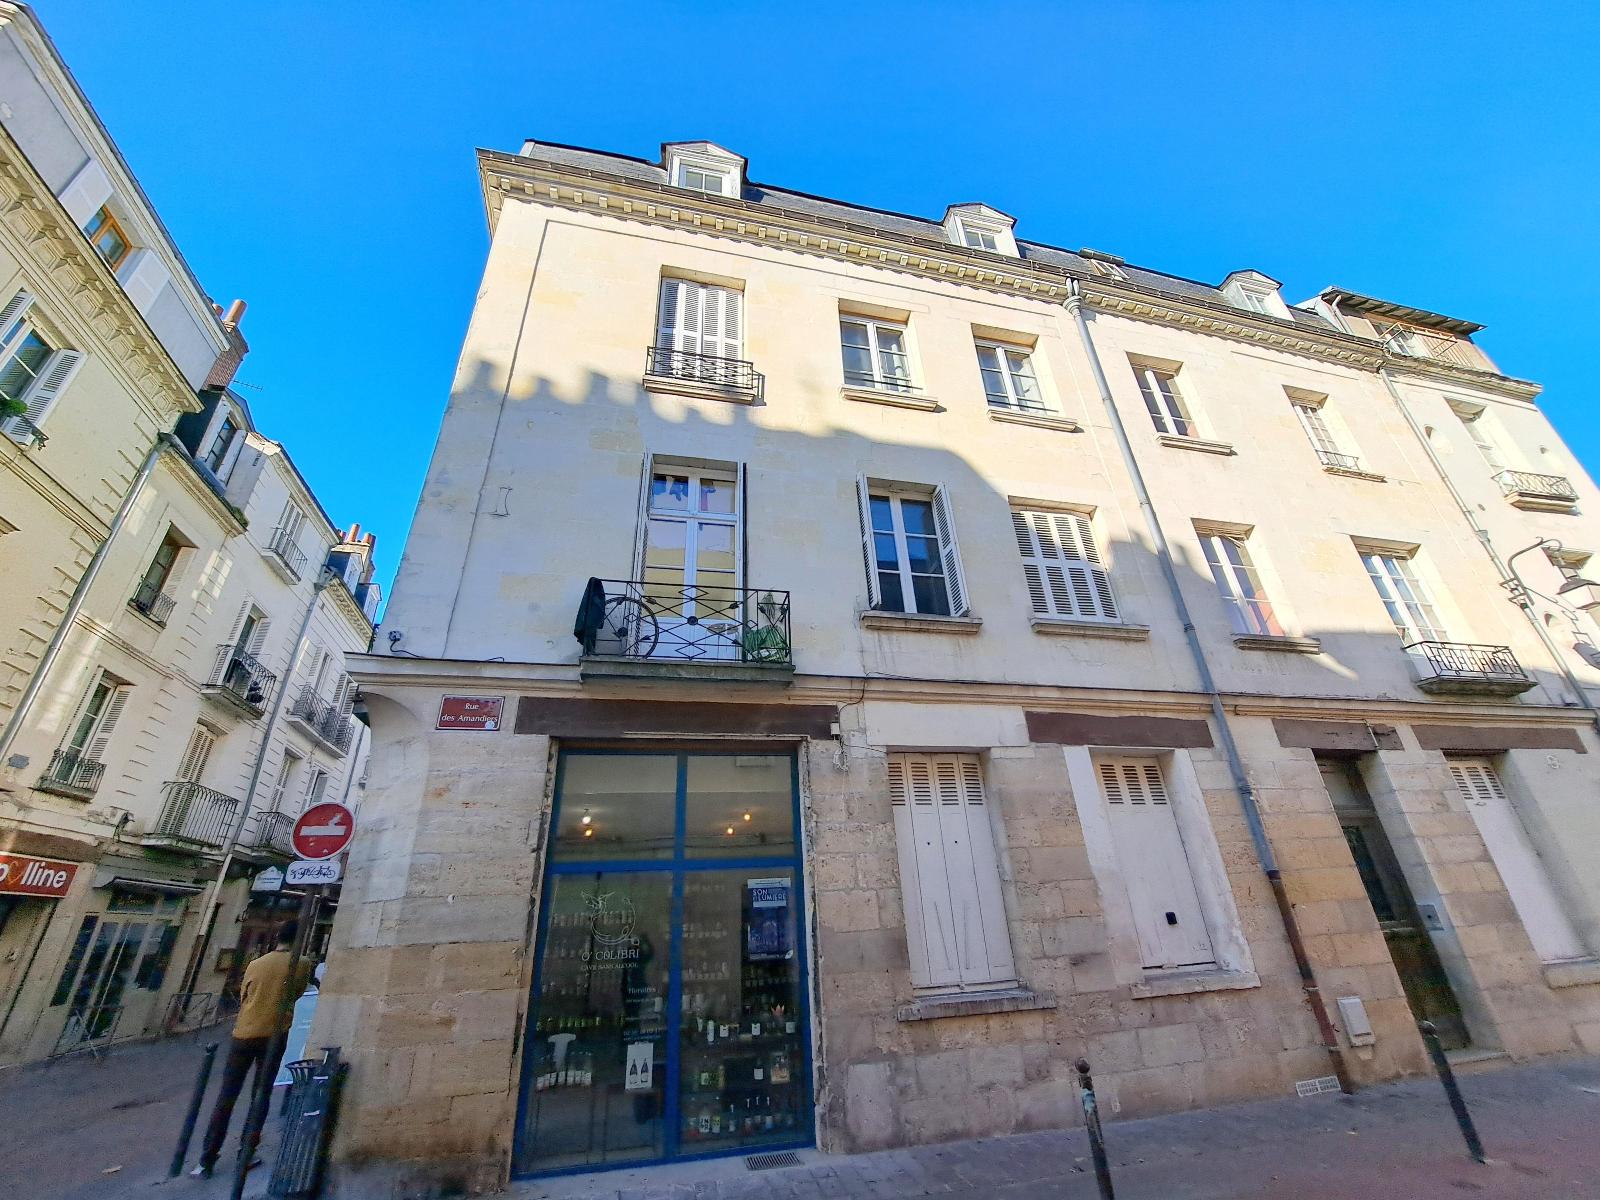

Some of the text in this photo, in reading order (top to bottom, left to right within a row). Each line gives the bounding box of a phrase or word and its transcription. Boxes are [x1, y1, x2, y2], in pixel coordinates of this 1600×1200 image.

[465, 702, 479, 710] Rue
[441, 714, 455, 722] des
[752, 888, 768, 896] SON
[595, 949, 639, 961] COLIBRI
